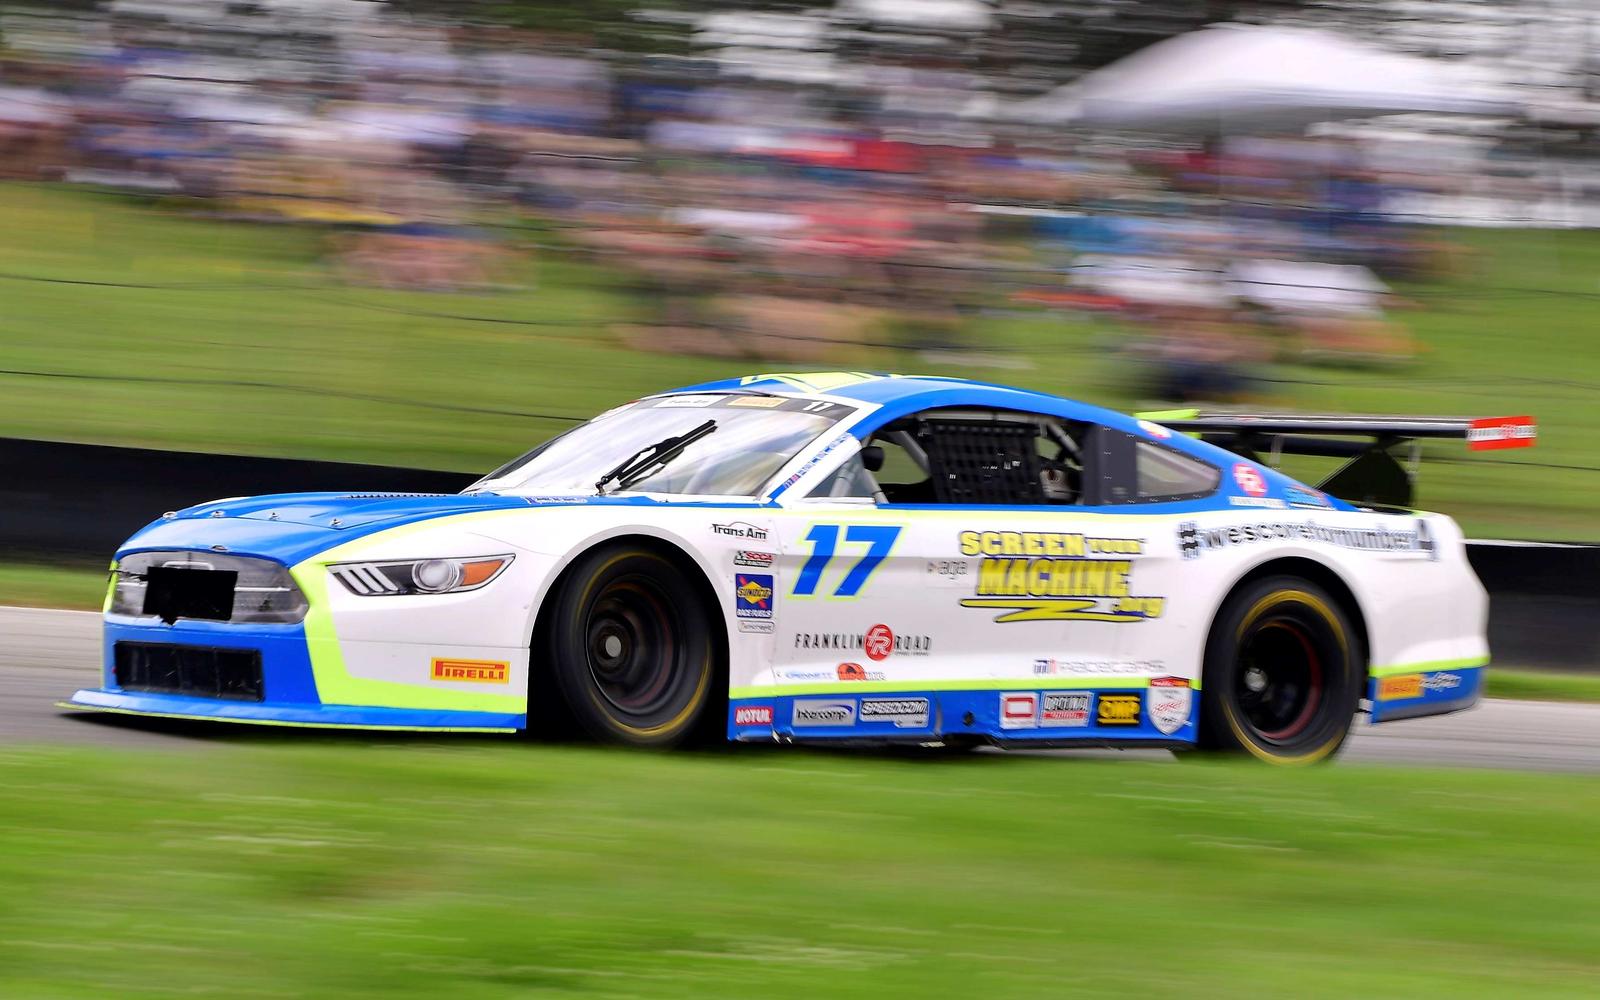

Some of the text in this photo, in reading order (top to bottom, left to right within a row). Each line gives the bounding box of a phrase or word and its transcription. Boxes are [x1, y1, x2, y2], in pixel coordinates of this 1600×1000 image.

[803, 401, 835, 411] 17
[712, 523, 767, 539] Trans Am
[958, 531, 1087, 557] SCREEN
[789, 523, 904, 597] 17
[975, 557, 1132, 597] MACHINE
[794, 633, 865, 649] FRANKLIN
[894, 635, 933, 650] ROAD
[435, 661, 505, 680] PIRELLI
[736, 708, 771, 724] MOTUL
[797, 708, 848, 721] Intercomp
